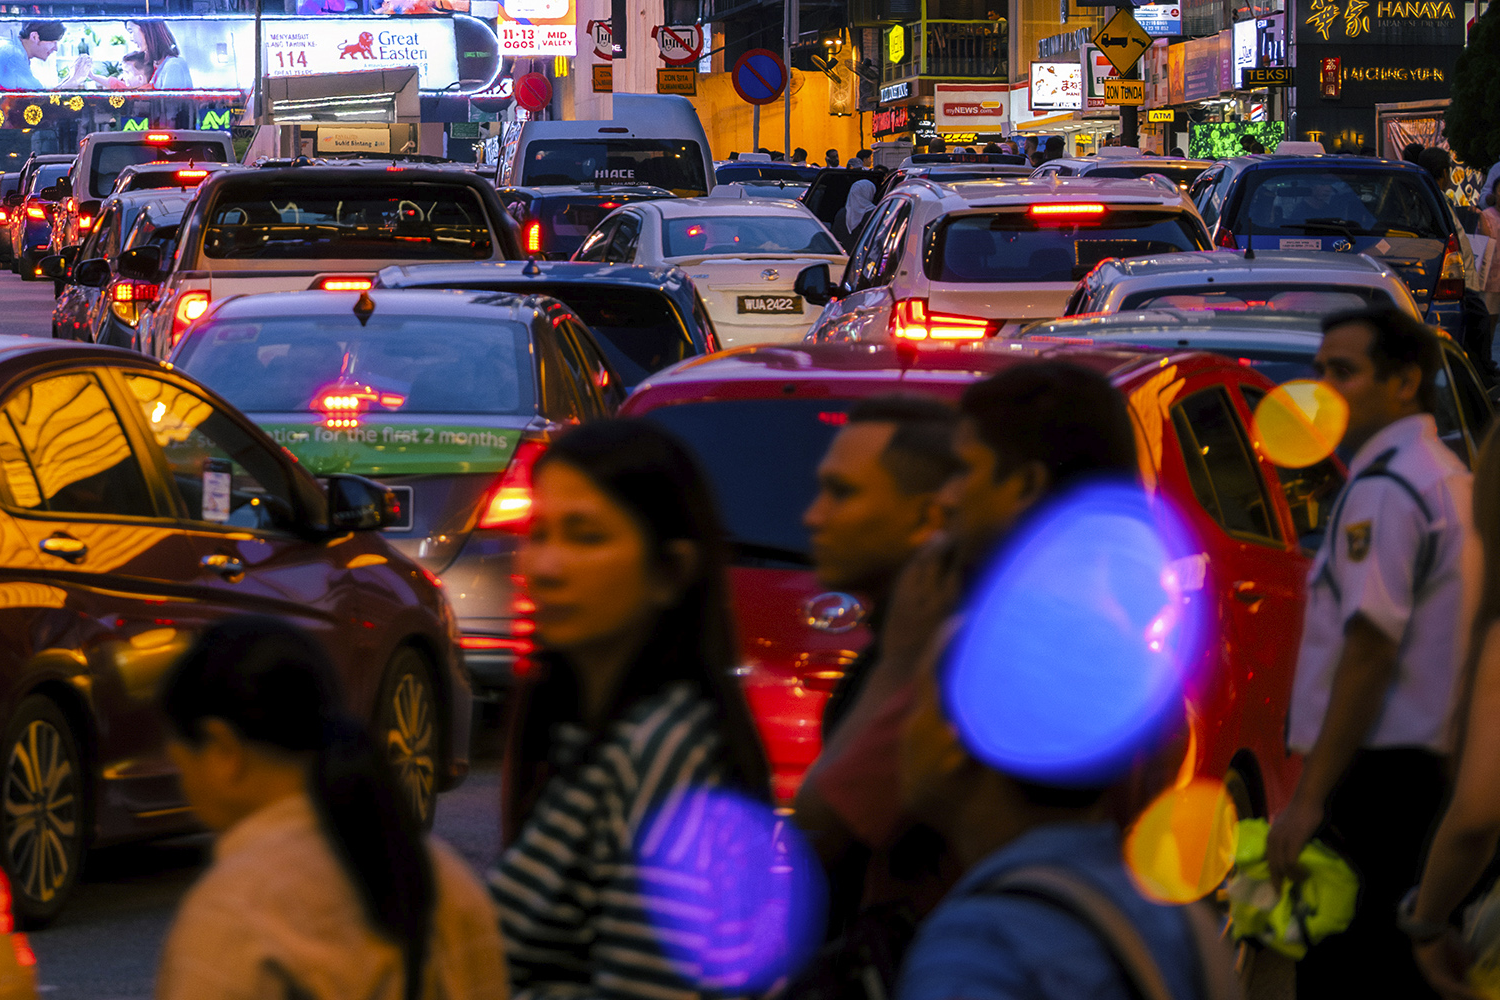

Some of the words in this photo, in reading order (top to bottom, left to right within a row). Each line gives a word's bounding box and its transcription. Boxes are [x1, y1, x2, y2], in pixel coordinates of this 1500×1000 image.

[1377, 1, 1456, 19] HANAYA
[378, 30, 419, 45] Great
[547, 31, 567, 39] MID
[504, 41, 534, 49] OGOS
[276, 51, 308, 67] 114
[1247, 70, 1288, 80] TEKSI
[1366, 68, 1408, 81] CHING
[1410, 68, 1445, 81] YUEN
[1106, 86, 1119, 99] ZON
[1120, 85, 1142, 100] TUNDA
[351, 140, 372, 148] Bintang
[595, 169, 634, 178] HIACE
[315, 427, 342, 443] for
[347, 427, 377, 443] the
[382, 427, 419, 443] first
[423, 428, 435, 443] 2
[439, 431, 508, 449] months
